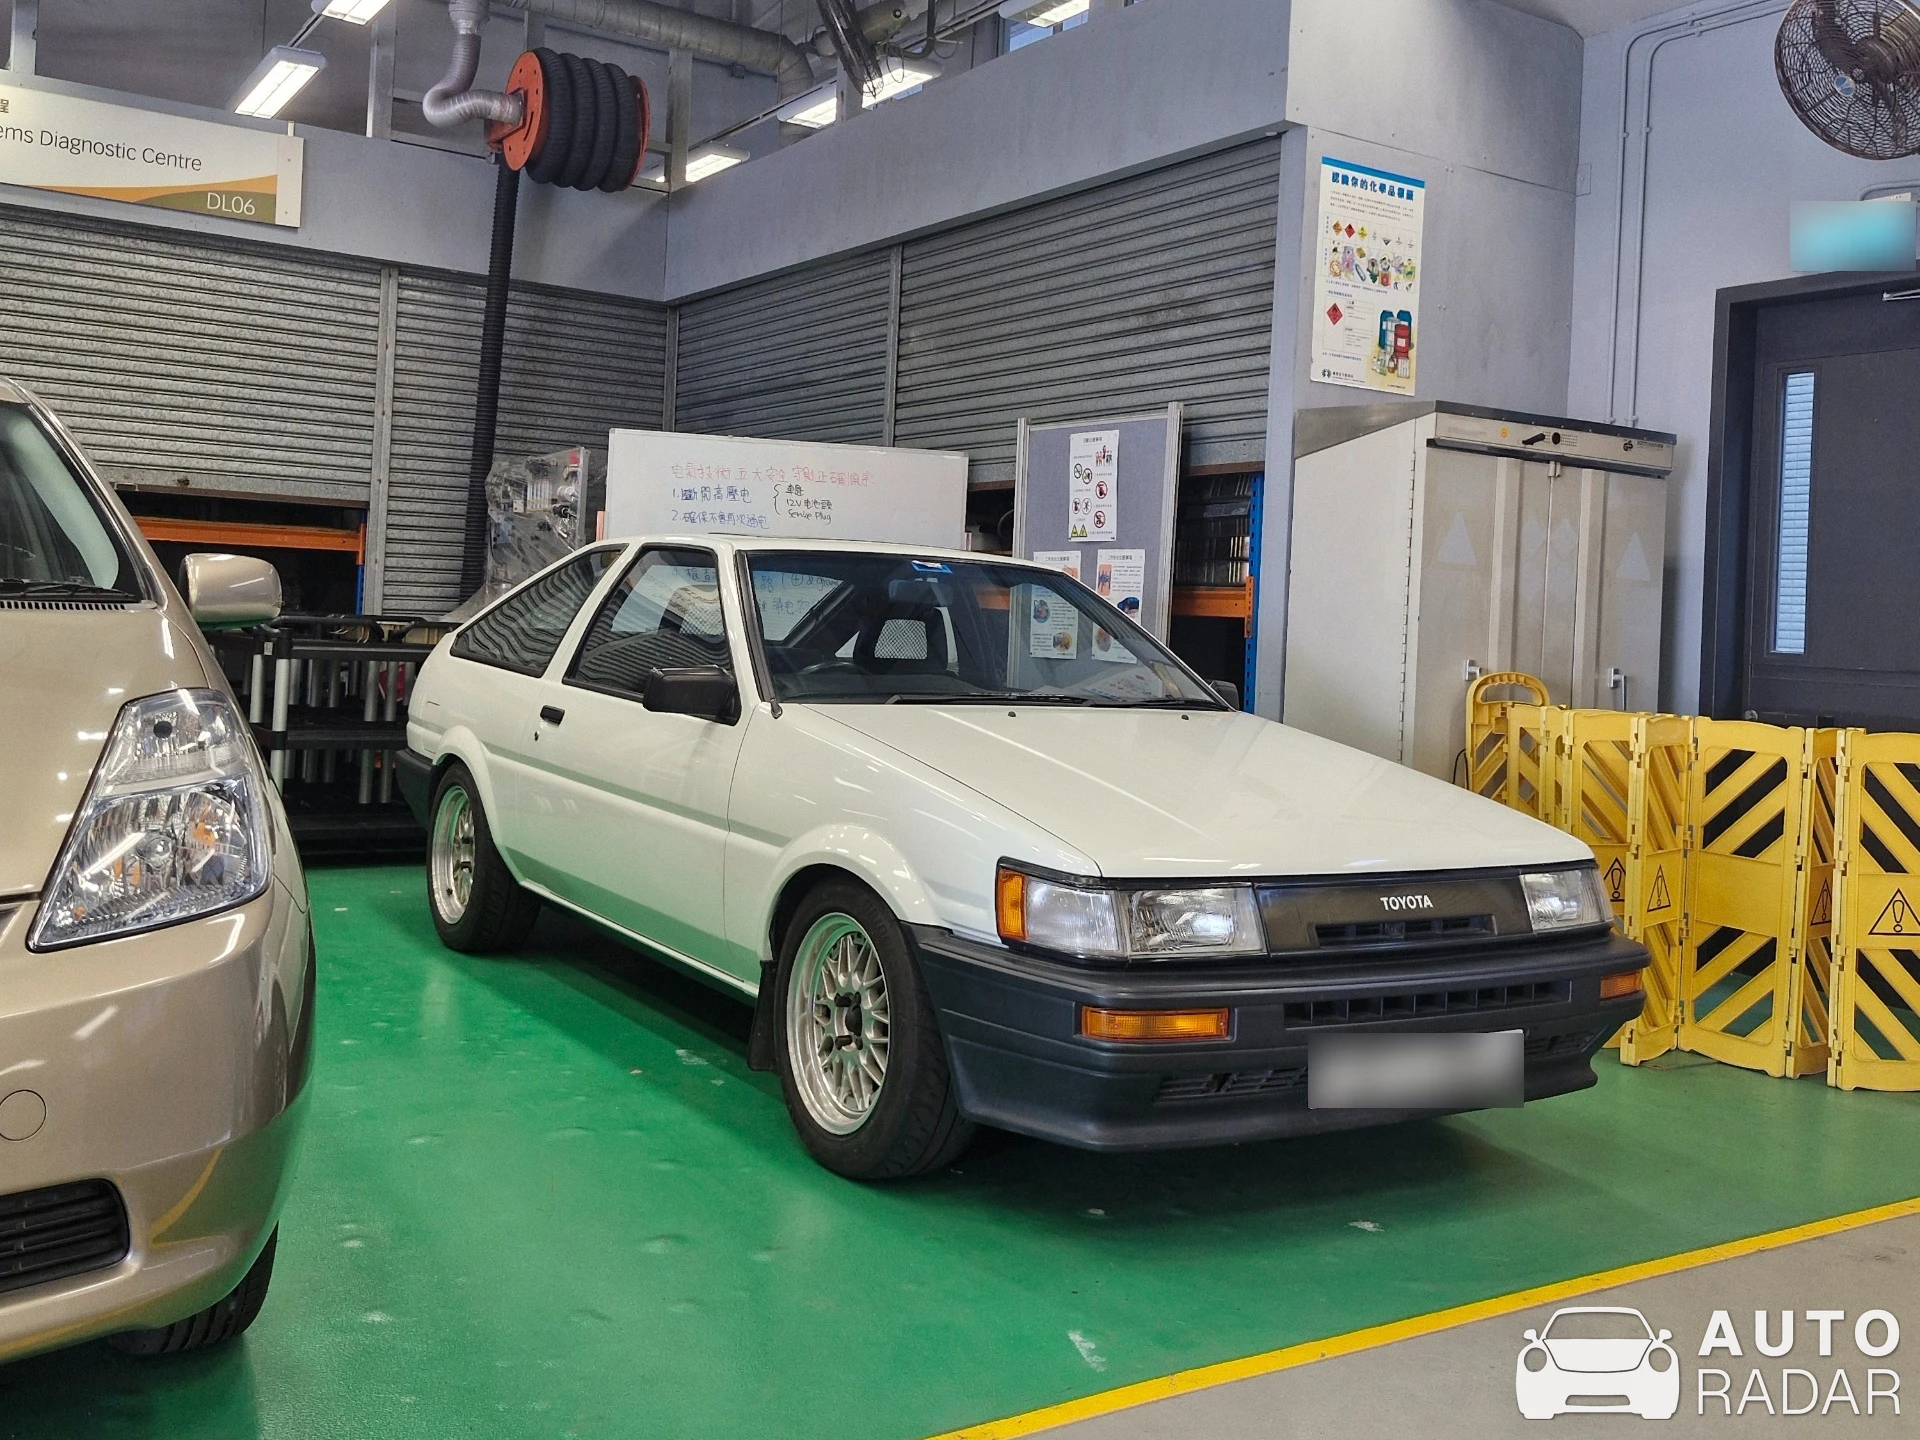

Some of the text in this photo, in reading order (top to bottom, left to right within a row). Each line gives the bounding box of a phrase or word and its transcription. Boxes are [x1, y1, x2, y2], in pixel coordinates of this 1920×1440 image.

[40, 130, 137, 161] Diagnostic
[142, 147, 202, 171] Centre
[206, 192, 256, 215] DL06
[814, 511, 832, 526] Plug
[1380, 895, 1433, 911] TOYOTA
